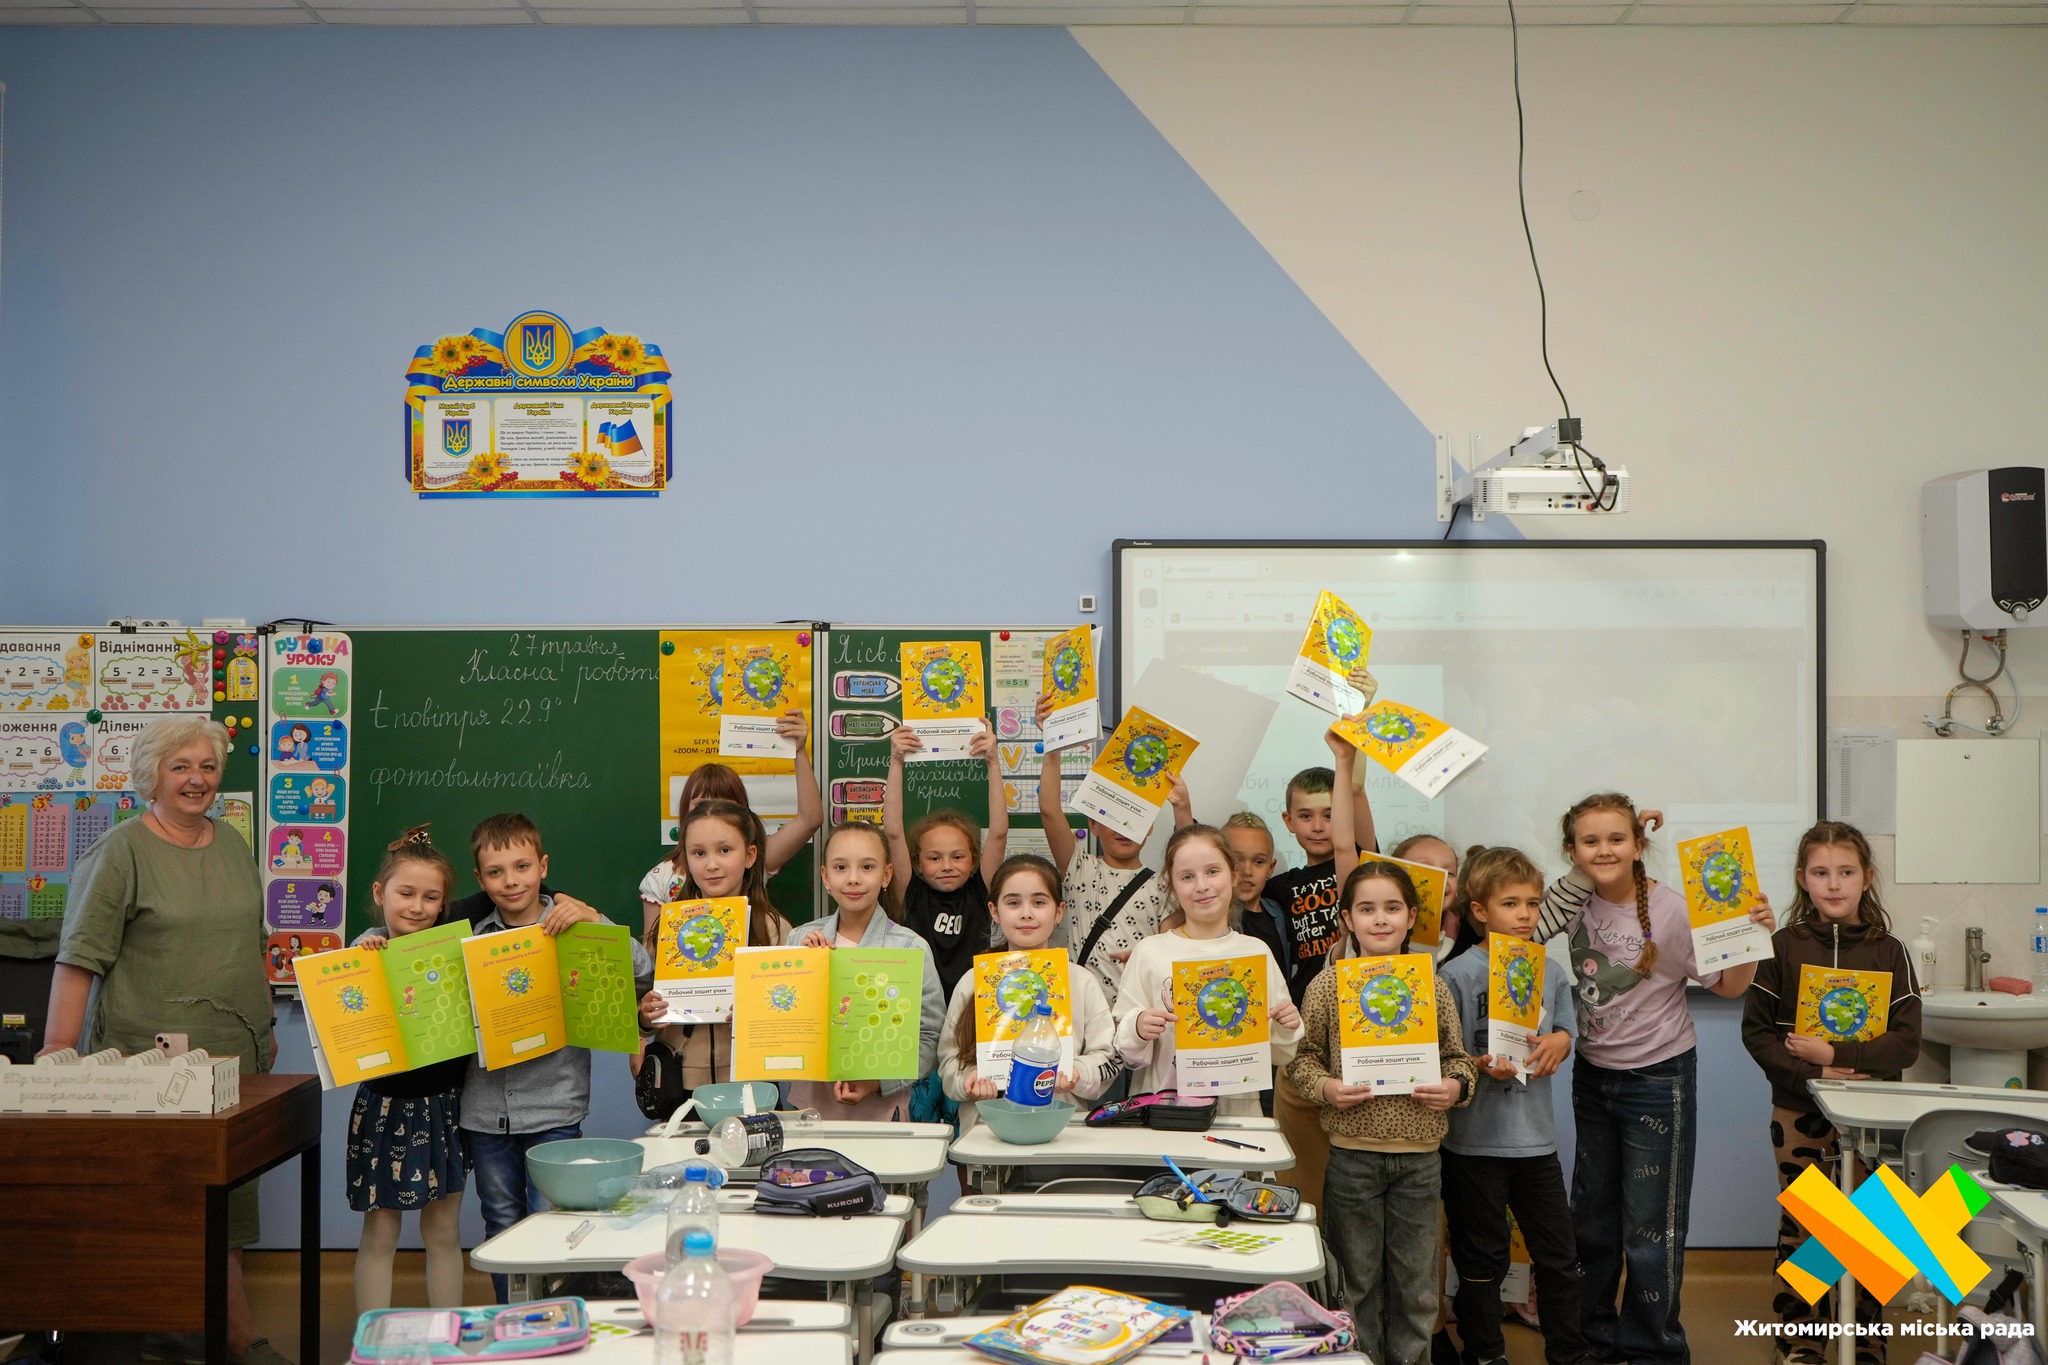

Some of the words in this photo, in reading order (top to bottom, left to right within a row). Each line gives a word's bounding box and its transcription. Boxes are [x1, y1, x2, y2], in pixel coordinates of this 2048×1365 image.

[444, 375, 513, 391] Державні
[516, 377, 576, 388] символи
[579, 374, 633, 389] України
[99, 641, 181, 654] Віднімання
[508, 633, 537, 656] 27
[540, 635, 625, 672] травня
[286, 653, 336, 666] УРОКУ
[18, 667, 26, 677] 2
[47, 667, 54, 676] 5
[113, 667, 120, 676] 5
[138, 667, 145, 676] 2
[166, 667, 173, 676] 3
[459, 649, 558, 684] Класна
[289, 674, 298, 685] 1
[1305, 668, 1327, 682] Робочий
[369, 690, 389, 729] t
[394, 697, 491, 749] повітря
[999, 706, 1022, 738] S
[98, 720, 146, 734] Ділен
[323, 725, 332, 736] 2
[15, 747, 23, 757] 2
[44, 746, 52, 756] 6
[111, 745, 119, 754] 6
[837, 743, 892, 774] Прине
[1000, 744, 1027, 773] V
[20, 779, 26, 788] 2
[283, 777, 293, 789] 3
[1366, 777, 1407, 789] млю
[36, 796, 45, 809] 3
[77, 798, 86, 809] 4
[121, 798, 129, 810] 5
[1095, 785, 1116, 802] Робочий
[1115, 797, 1130, 808] зошит
[1130, 804, 1142, 814] учня
[323, 831, 332, 841] 4
[286, 883, 296, 893] 5
[1291, 886, 1300, 898] I
[933, 912, 963, 935] CEO
[1291, 914, 1309, 930] but
[1309, 911, 1318, 925] I
[1296, 925, 1326, 942] after
[1726, 929, 1741, 938] зошит
[321, 936, 330, 947] 6
[494, 953, 523, 965] захищають
[524, 948, 544, 958] клімат!
[316, 978, 327, 986] Діти
[327, 973, 354, 983] захищають
[354, 968, 372, 977] клімат!
[763, 971, 794, 979] захищають
[794, 969, 814, 977] клімат!
[1192, 1059, 1219, 1067] Робочий
[1357, 1056, 1384, 1065] Робочий
[1384, 1056, 1405, 1064] зошит
[1640, 1113, 1669, 1135] miu
[412, 1138, 430, 1147] COOL
[1634, 1164, 1660, 1180] miu
[826, 1196, 865, 1210] KUROMI
[1636, 1226, 1662, 1244] miu
[1055, 1322, 1093, 1335] ДІТИ
[1060, 1313, 1110, 1331] ОСВІТА
